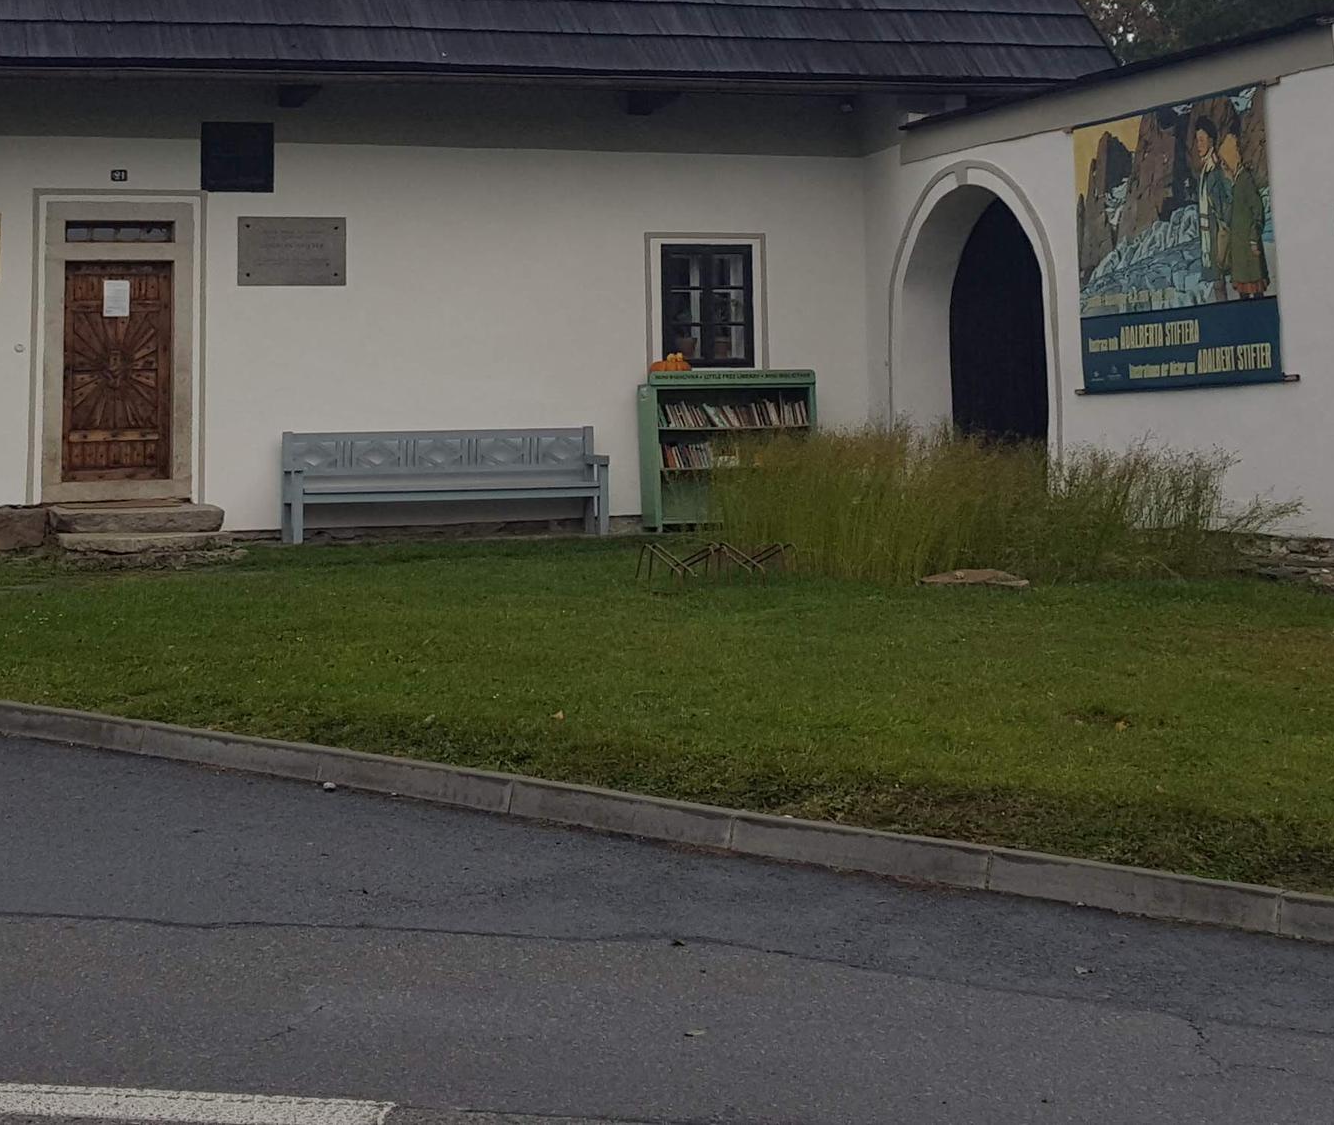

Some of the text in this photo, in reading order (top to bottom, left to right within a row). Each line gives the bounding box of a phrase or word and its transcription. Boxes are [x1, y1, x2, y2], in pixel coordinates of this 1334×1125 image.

[1119, 323, 1164, 350] ADALBERTA
[1165, 319, 1200, 346] STIFTERA
[1197, 346, 1236, 374] ADALBERT
[1236, 342, 1272, 370] STIFTER
